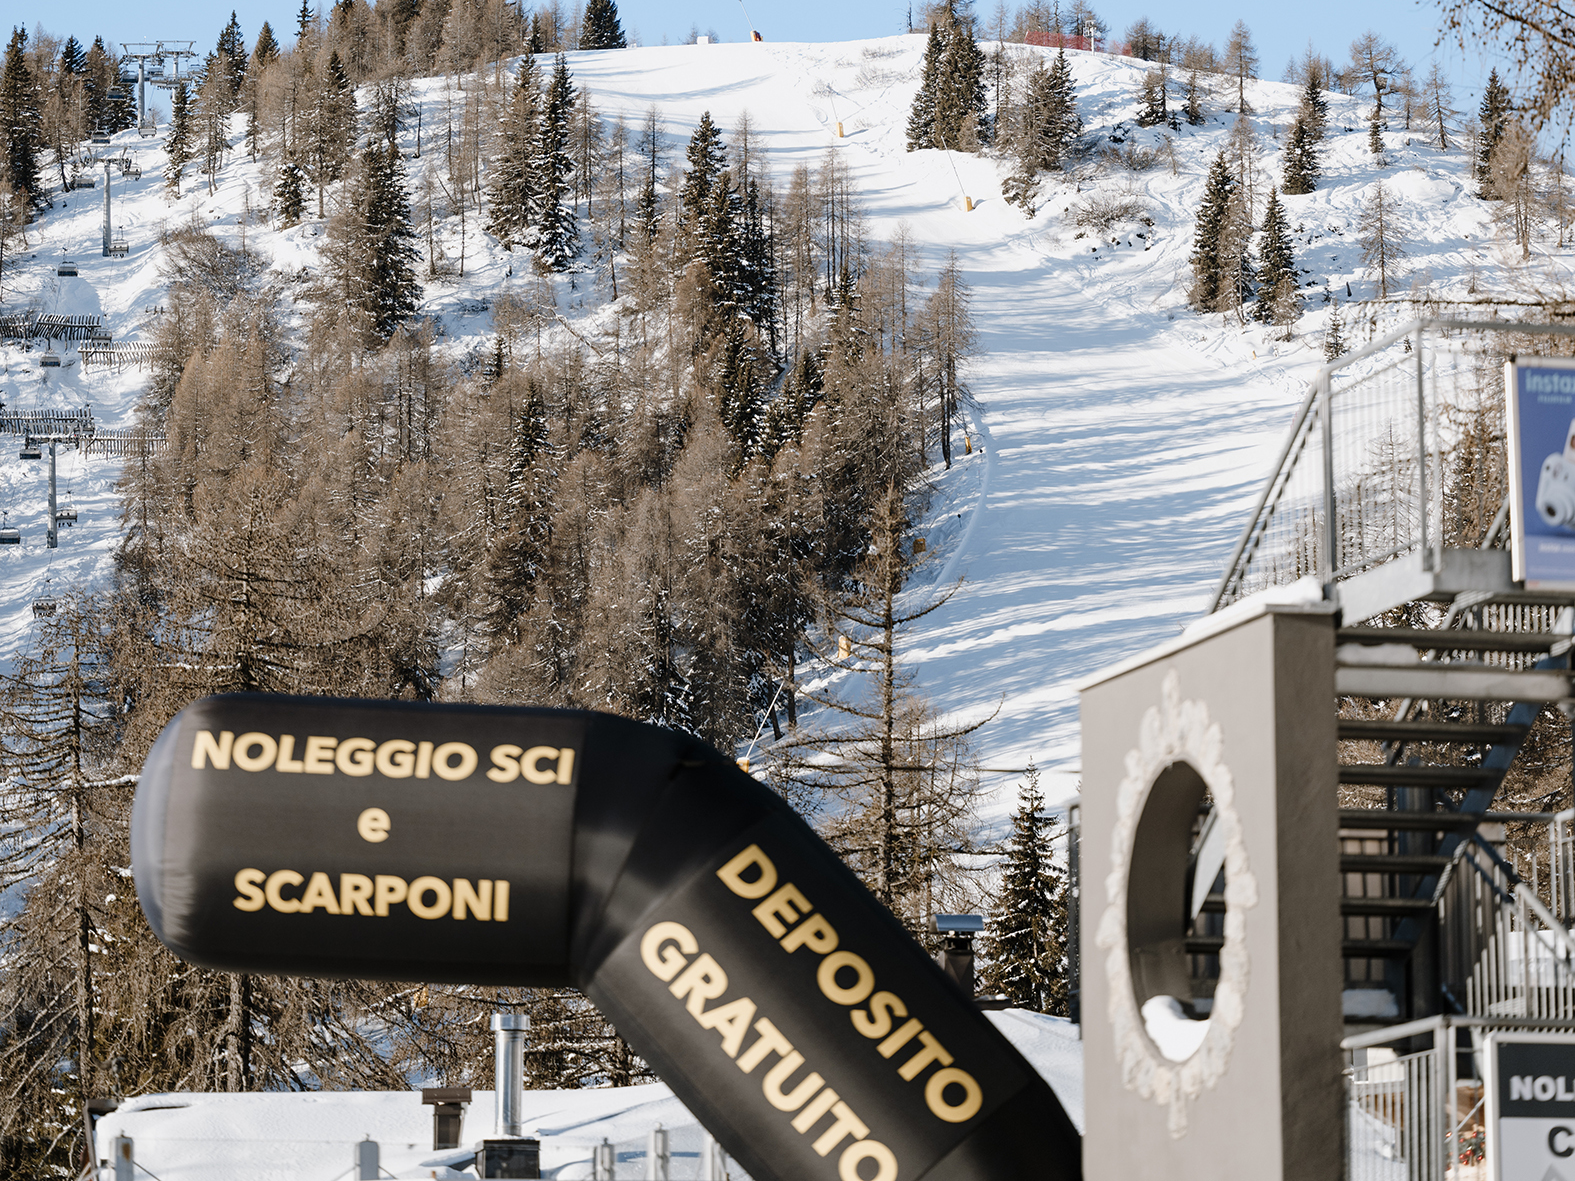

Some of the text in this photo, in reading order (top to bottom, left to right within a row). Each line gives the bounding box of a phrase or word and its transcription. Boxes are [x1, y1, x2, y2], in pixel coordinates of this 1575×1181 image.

[1526, 369, 1575, 394] insta
[190, 730, 575, 786] NOLEGGIO SCI
[357, 807, 392, 844] e
[233, 868, 510, 923] SCARPONI
[716, 843, 984, 1124] DEPOSITO
[640, 921, 899, 1181] GRATUITO
[1509, 1075, 1575, 1102] NOL
